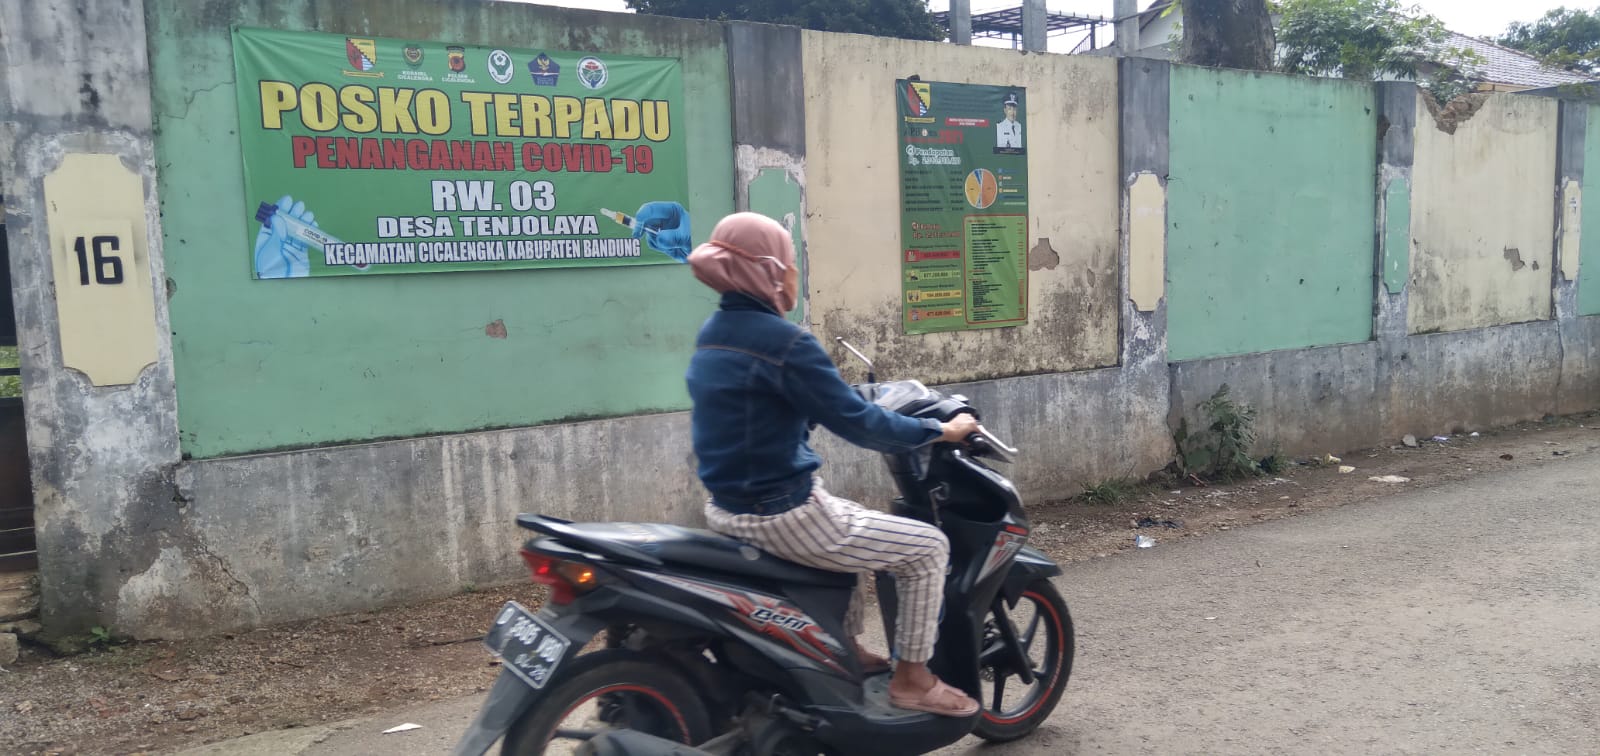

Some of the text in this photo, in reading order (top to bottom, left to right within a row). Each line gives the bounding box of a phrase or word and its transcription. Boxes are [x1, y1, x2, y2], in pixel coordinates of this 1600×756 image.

[258, 80, 671, 142] POSKO TERPADU
[292, 135, 654, 174] PENANGANAN COVID-19
[431, 180, 556, 212] RW. 03
[377, 214, 599, 239] DESA TENJOLAYA
[74, 235, 124, 286] 16
[324, 238, 641, 266] KECAMATAN CICALENGKA KABUPATEN BANDUNG
